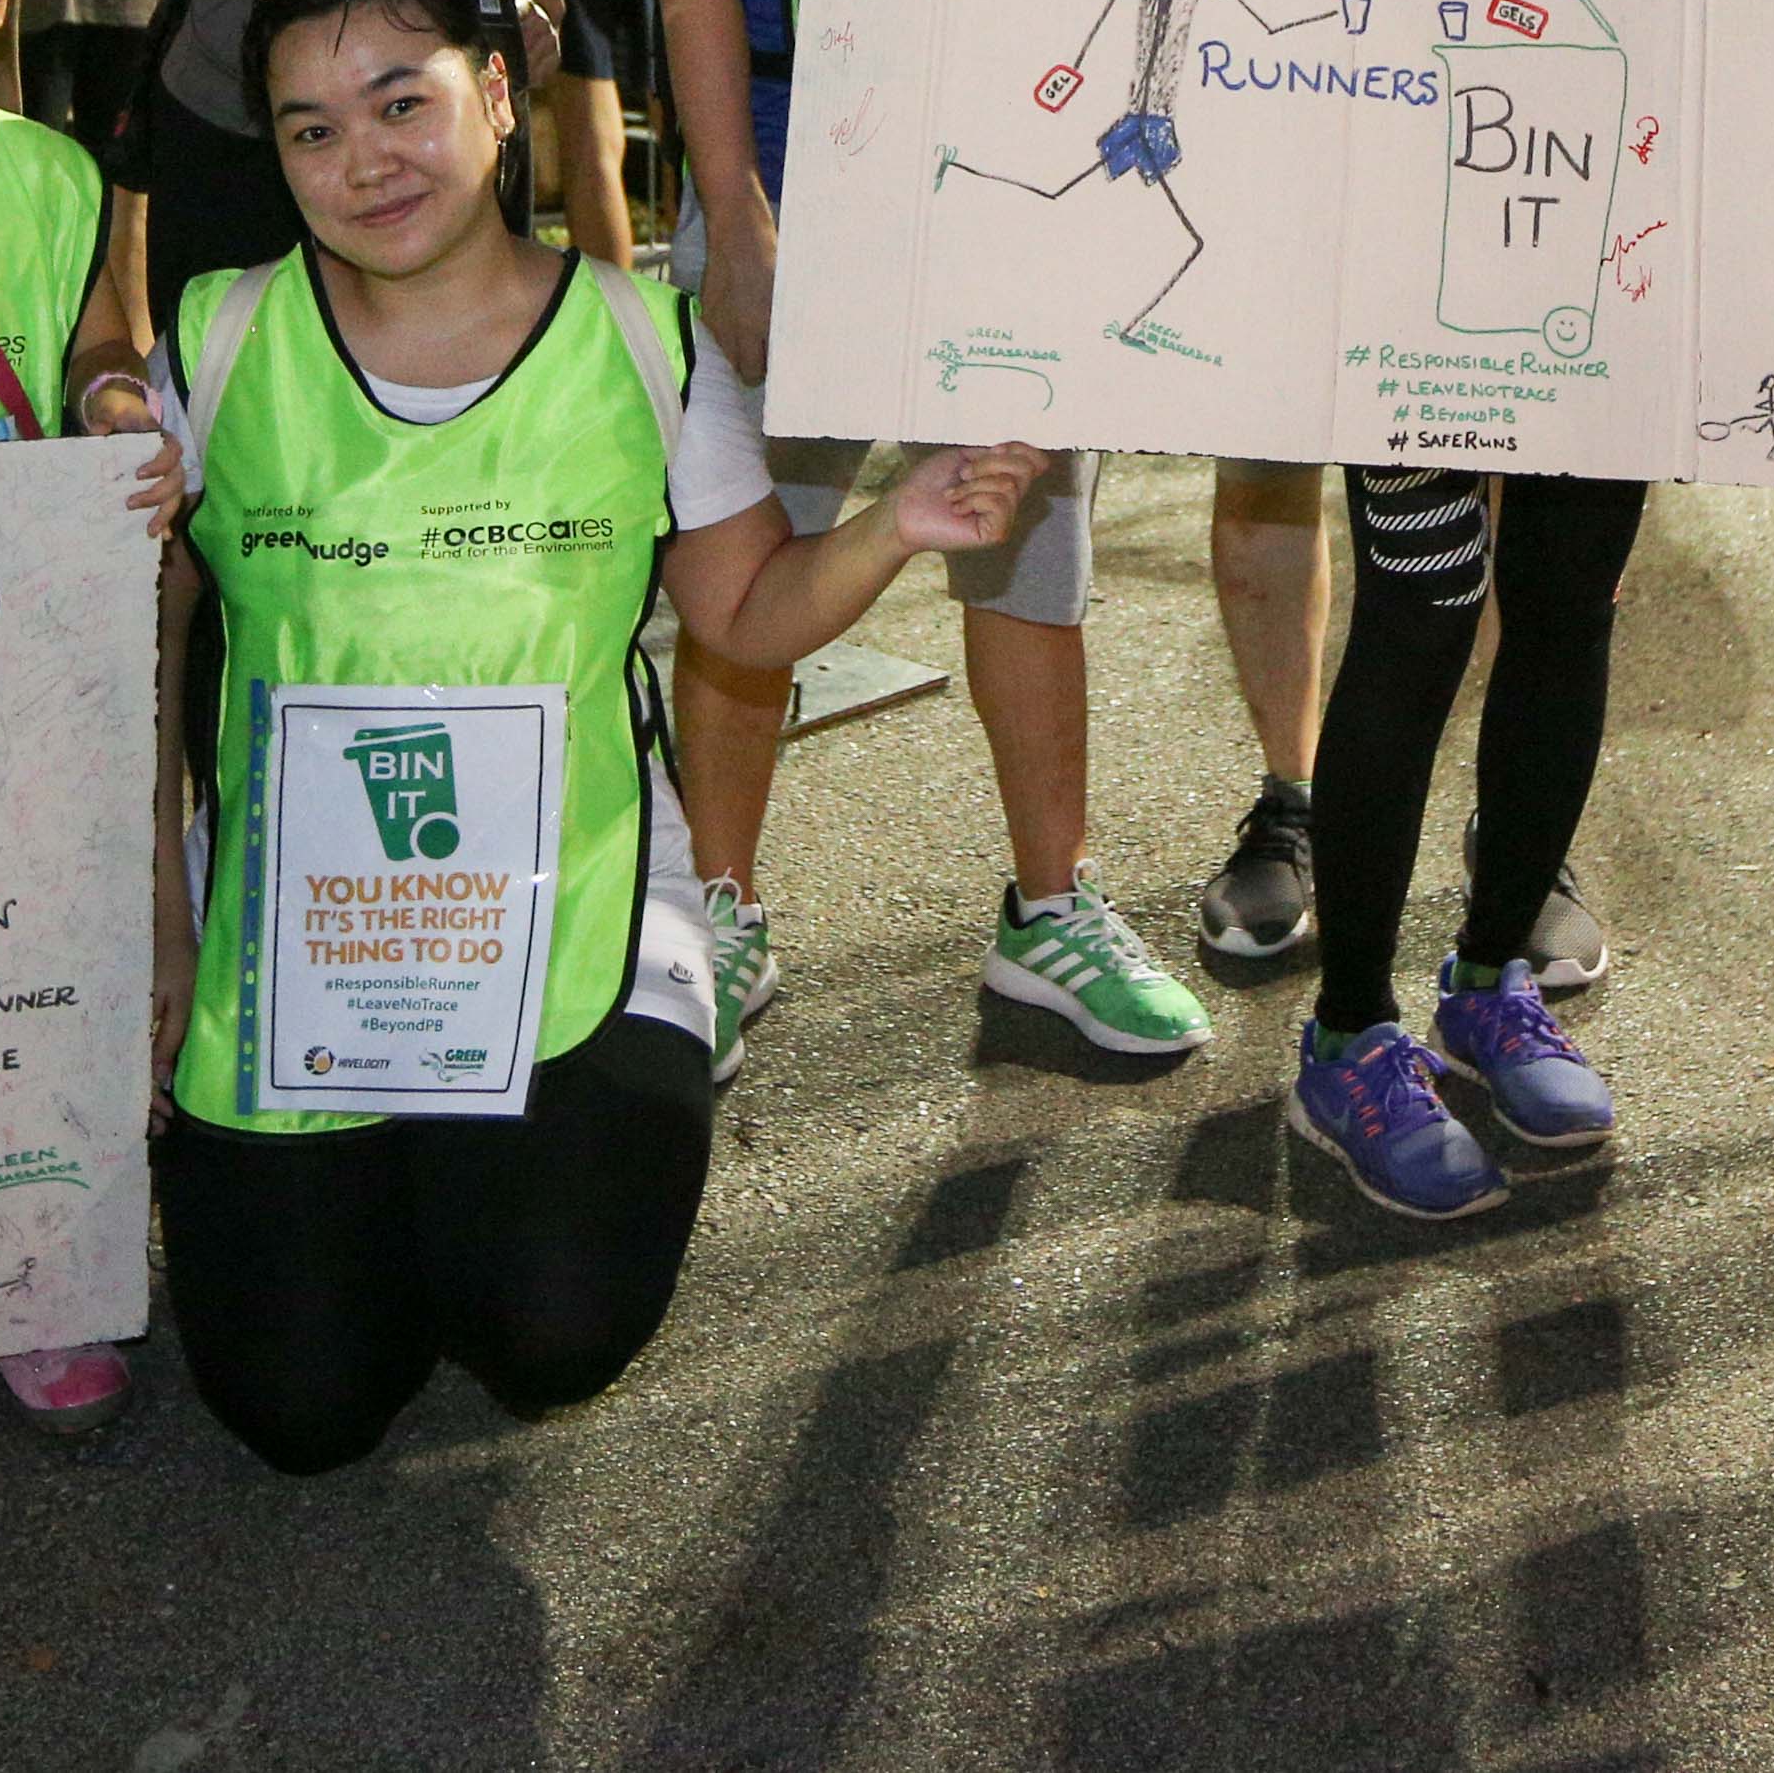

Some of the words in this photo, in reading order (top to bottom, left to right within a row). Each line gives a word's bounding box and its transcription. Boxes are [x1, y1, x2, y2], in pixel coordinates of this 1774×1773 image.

[1498, 3, 1538, 31] GELS
[1199, 39, 1439, 107] RUNNERS
[1044, 74, 1073, 102] GEL
[1454, 84, 1593, 182] BIN
[1503, 195, 1561, 249] IT
[243, 505, 295, 519] Initiated
[297, 505, 315, 519] by
[421, 500, 491, 515] Supported
[495, 498, 512, 512] by
[421, 546, 463, 560] Fund
[467, 546, 489, 558] for
[493, 544, 519, 557] the
[524, 539, 615, 556] Environment
[369, 750, 445, 781] BIN
[385, 790, 427, 821] IT
[305, 874, 383, 905] YOU
[390, 871, 510, 903] KNOW
[304, 909, 355, 934] IT'S
[359, 906, 415, 932] THE
[421, 906, 507, 931] RIGHT
[305, 937, 405, 965] THING
[409, 937, 453, 964] TO
[457, 937, 505, 965] DO
[325, 976, 482, 992] #ResponsibleRunner
[347, 997, 460, 1012] #LeaveNoTrace
[360, 1018, 445, 1035] #BeyondPB
[337, 1056, 393, 1071] HIVELOCITY
[444, 1048, 488, 1063] GREEN
